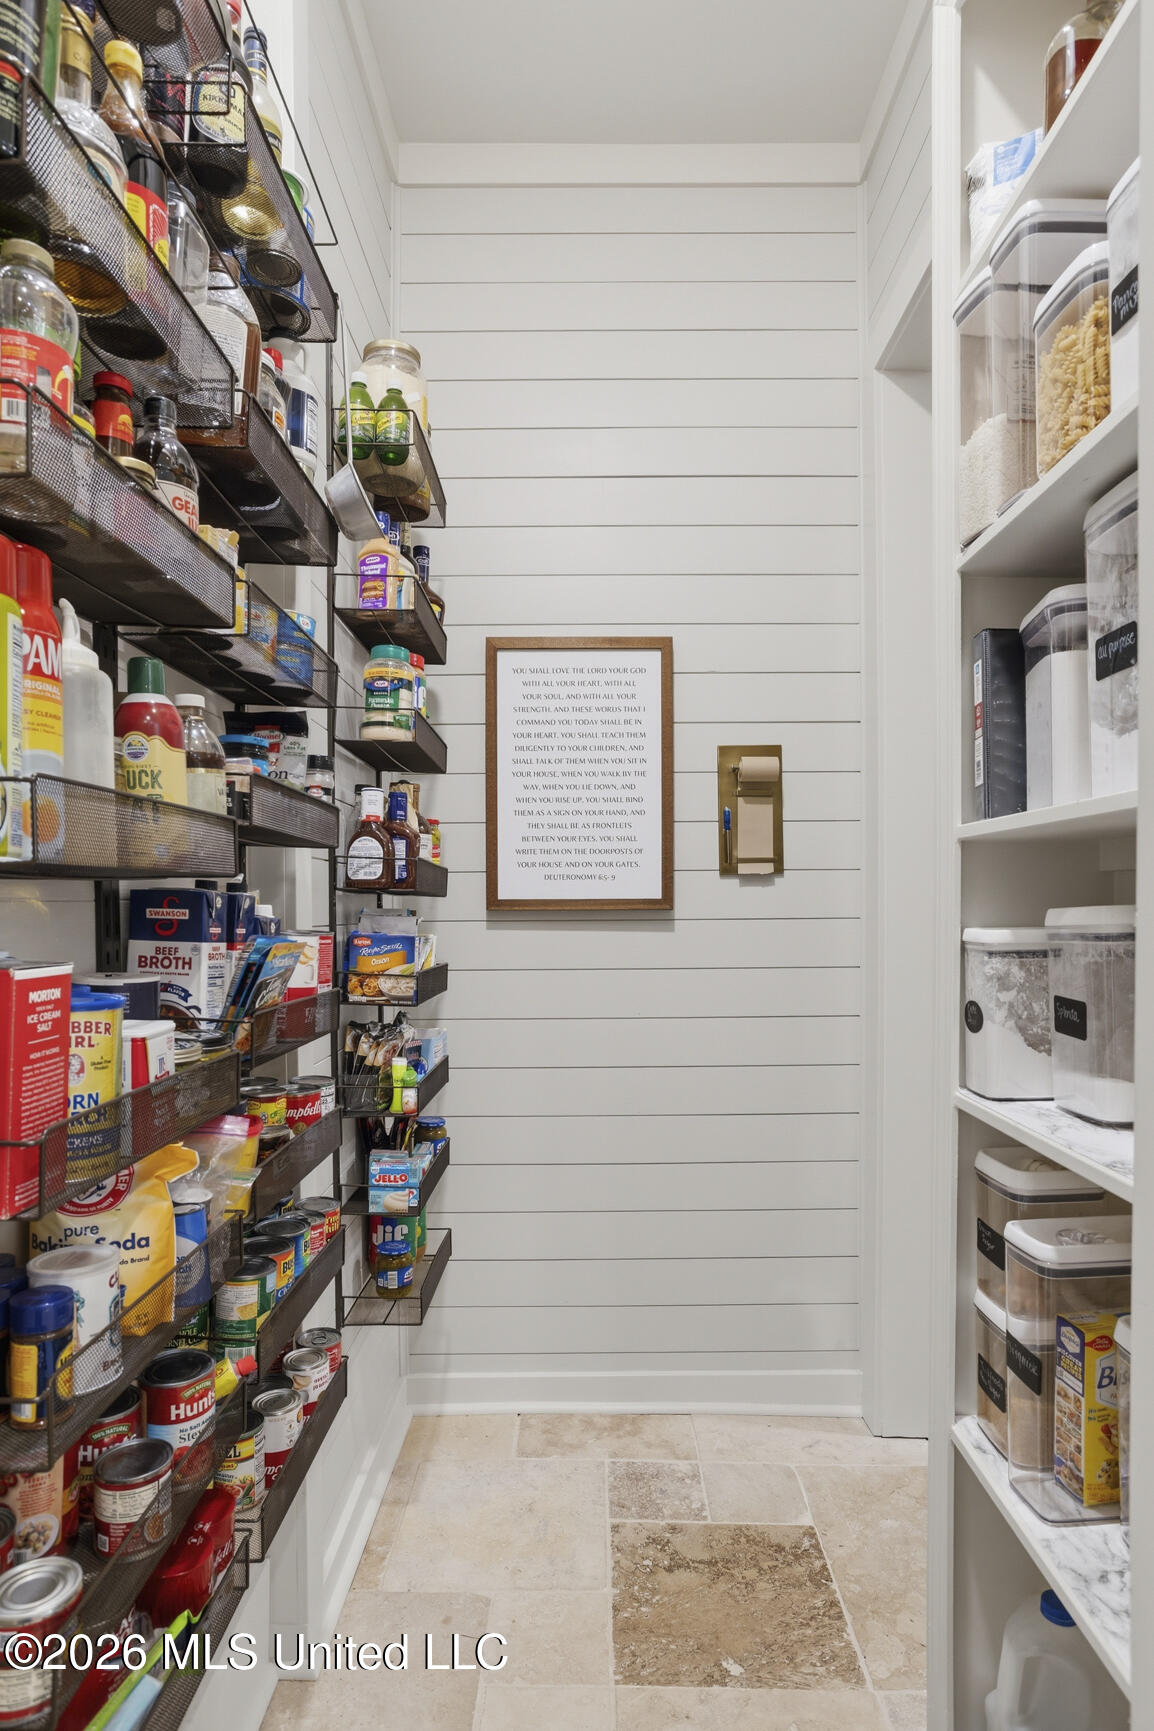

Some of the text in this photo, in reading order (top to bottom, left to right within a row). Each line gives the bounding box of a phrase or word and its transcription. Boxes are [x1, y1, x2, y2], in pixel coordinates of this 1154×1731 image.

[23, 679, 60, 696] RIGINAL
[126, 769, 163, 790] UCK
[148, 909, 187, 918] SWANSON
[155, 946, 180, 956] BEEF
[138, 955, 192, 970] BROTH
[28, 988, 61, 1004] MORTON
[27, 1010, 61, 1024] ICE CREAM
[37, 1022, 52, 1032] SALT
[71, 1021, 112, 1035] BBER
[69, 1036, 95, 1048] IRL
[64, 1225, 99, 1240] pure
[372, 1224, 409, 1245] Jif
